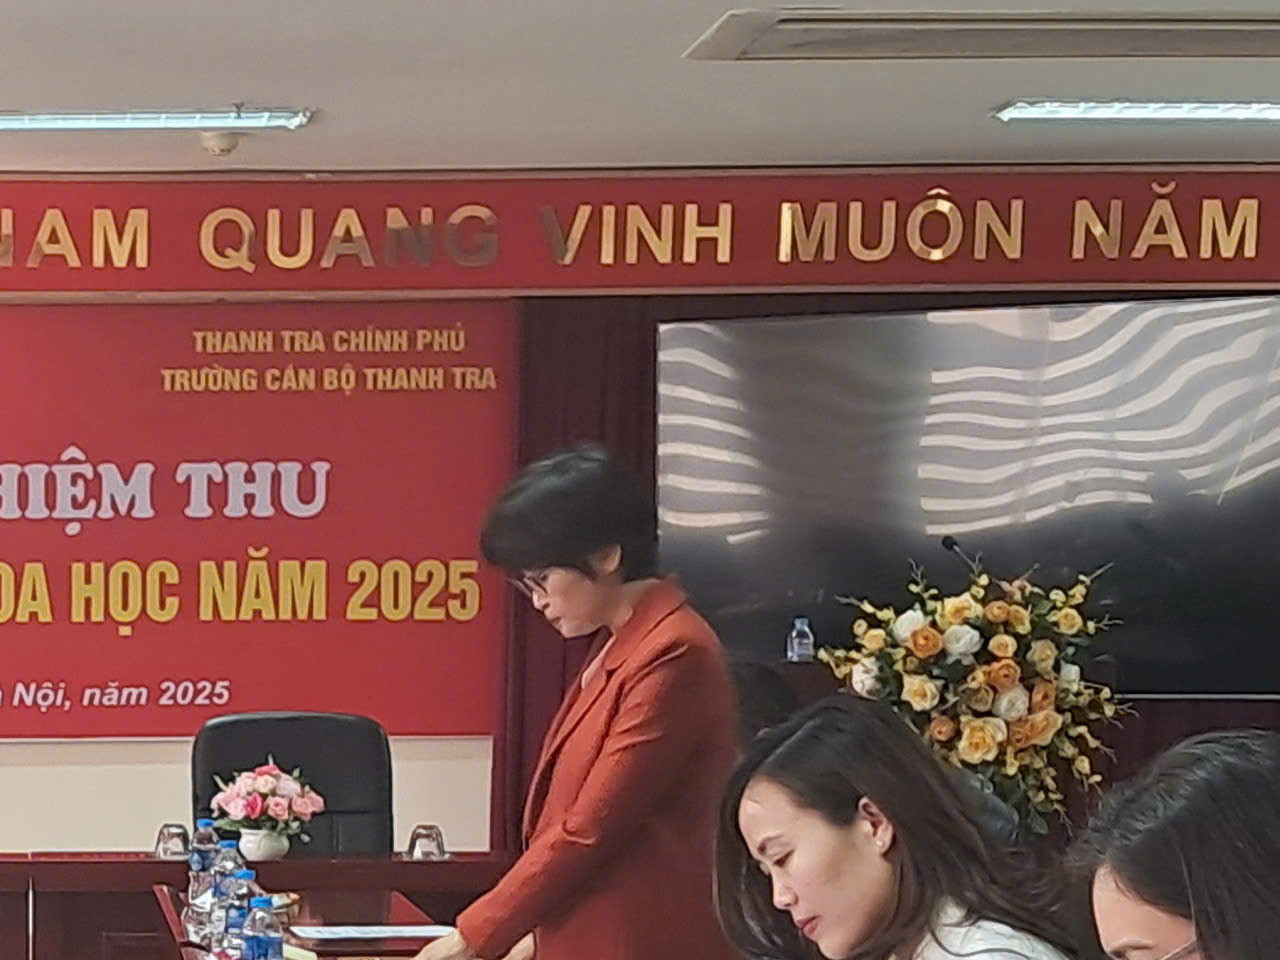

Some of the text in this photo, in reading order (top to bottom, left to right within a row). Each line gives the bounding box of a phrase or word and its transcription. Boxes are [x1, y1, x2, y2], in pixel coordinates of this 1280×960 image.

[199, 204, 500, 273] QUANG
[540, 202, 733, 265] VINH
[777, 187, 1024, 263] MUÔN
[1071, 180, 1260, 260] NĂM
[193, 322, 466, 353] THANH TRA CHÍNH PHỦ
[161, 362, 496, 395] TRƯỜNG CÁN BỘ THANH TRA
[176, 459, 332, 518] THU
[72, 560, 180, 637] HỌC
[199, 546, 324, 622] NĂM
[345, 558, 482, 622] 2025
[12, 681, 73, 713] Nội,
[82, 682, 149, 706] năm
[158, 681, 231, 706] 2025
